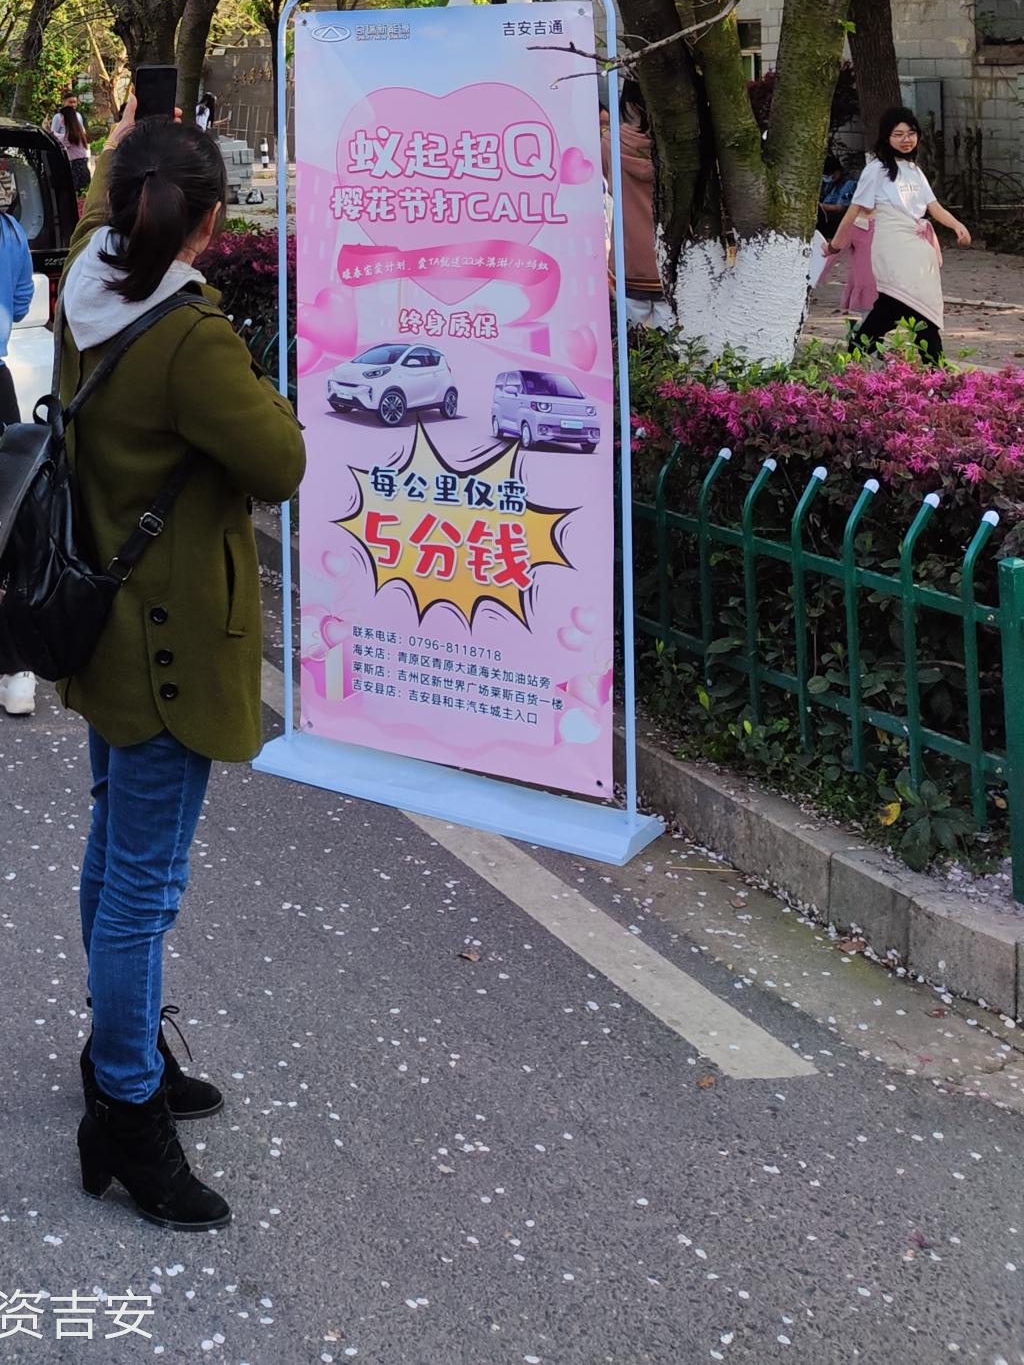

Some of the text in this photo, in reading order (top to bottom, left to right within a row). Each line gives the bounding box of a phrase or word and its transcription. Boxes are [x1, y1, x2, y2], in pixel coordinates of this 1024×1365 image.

[502, 20, 564, 36] 吉安吉通
[348, 121, 557, 181] 蚁起超Q
[331, 186, 568, 224] 樱花节打CALL
[399, 309, 499, 339] 终身质保
[370, 467, 527, 514] 每公里仅需
[365, 511, 533, 589] 5分钱
